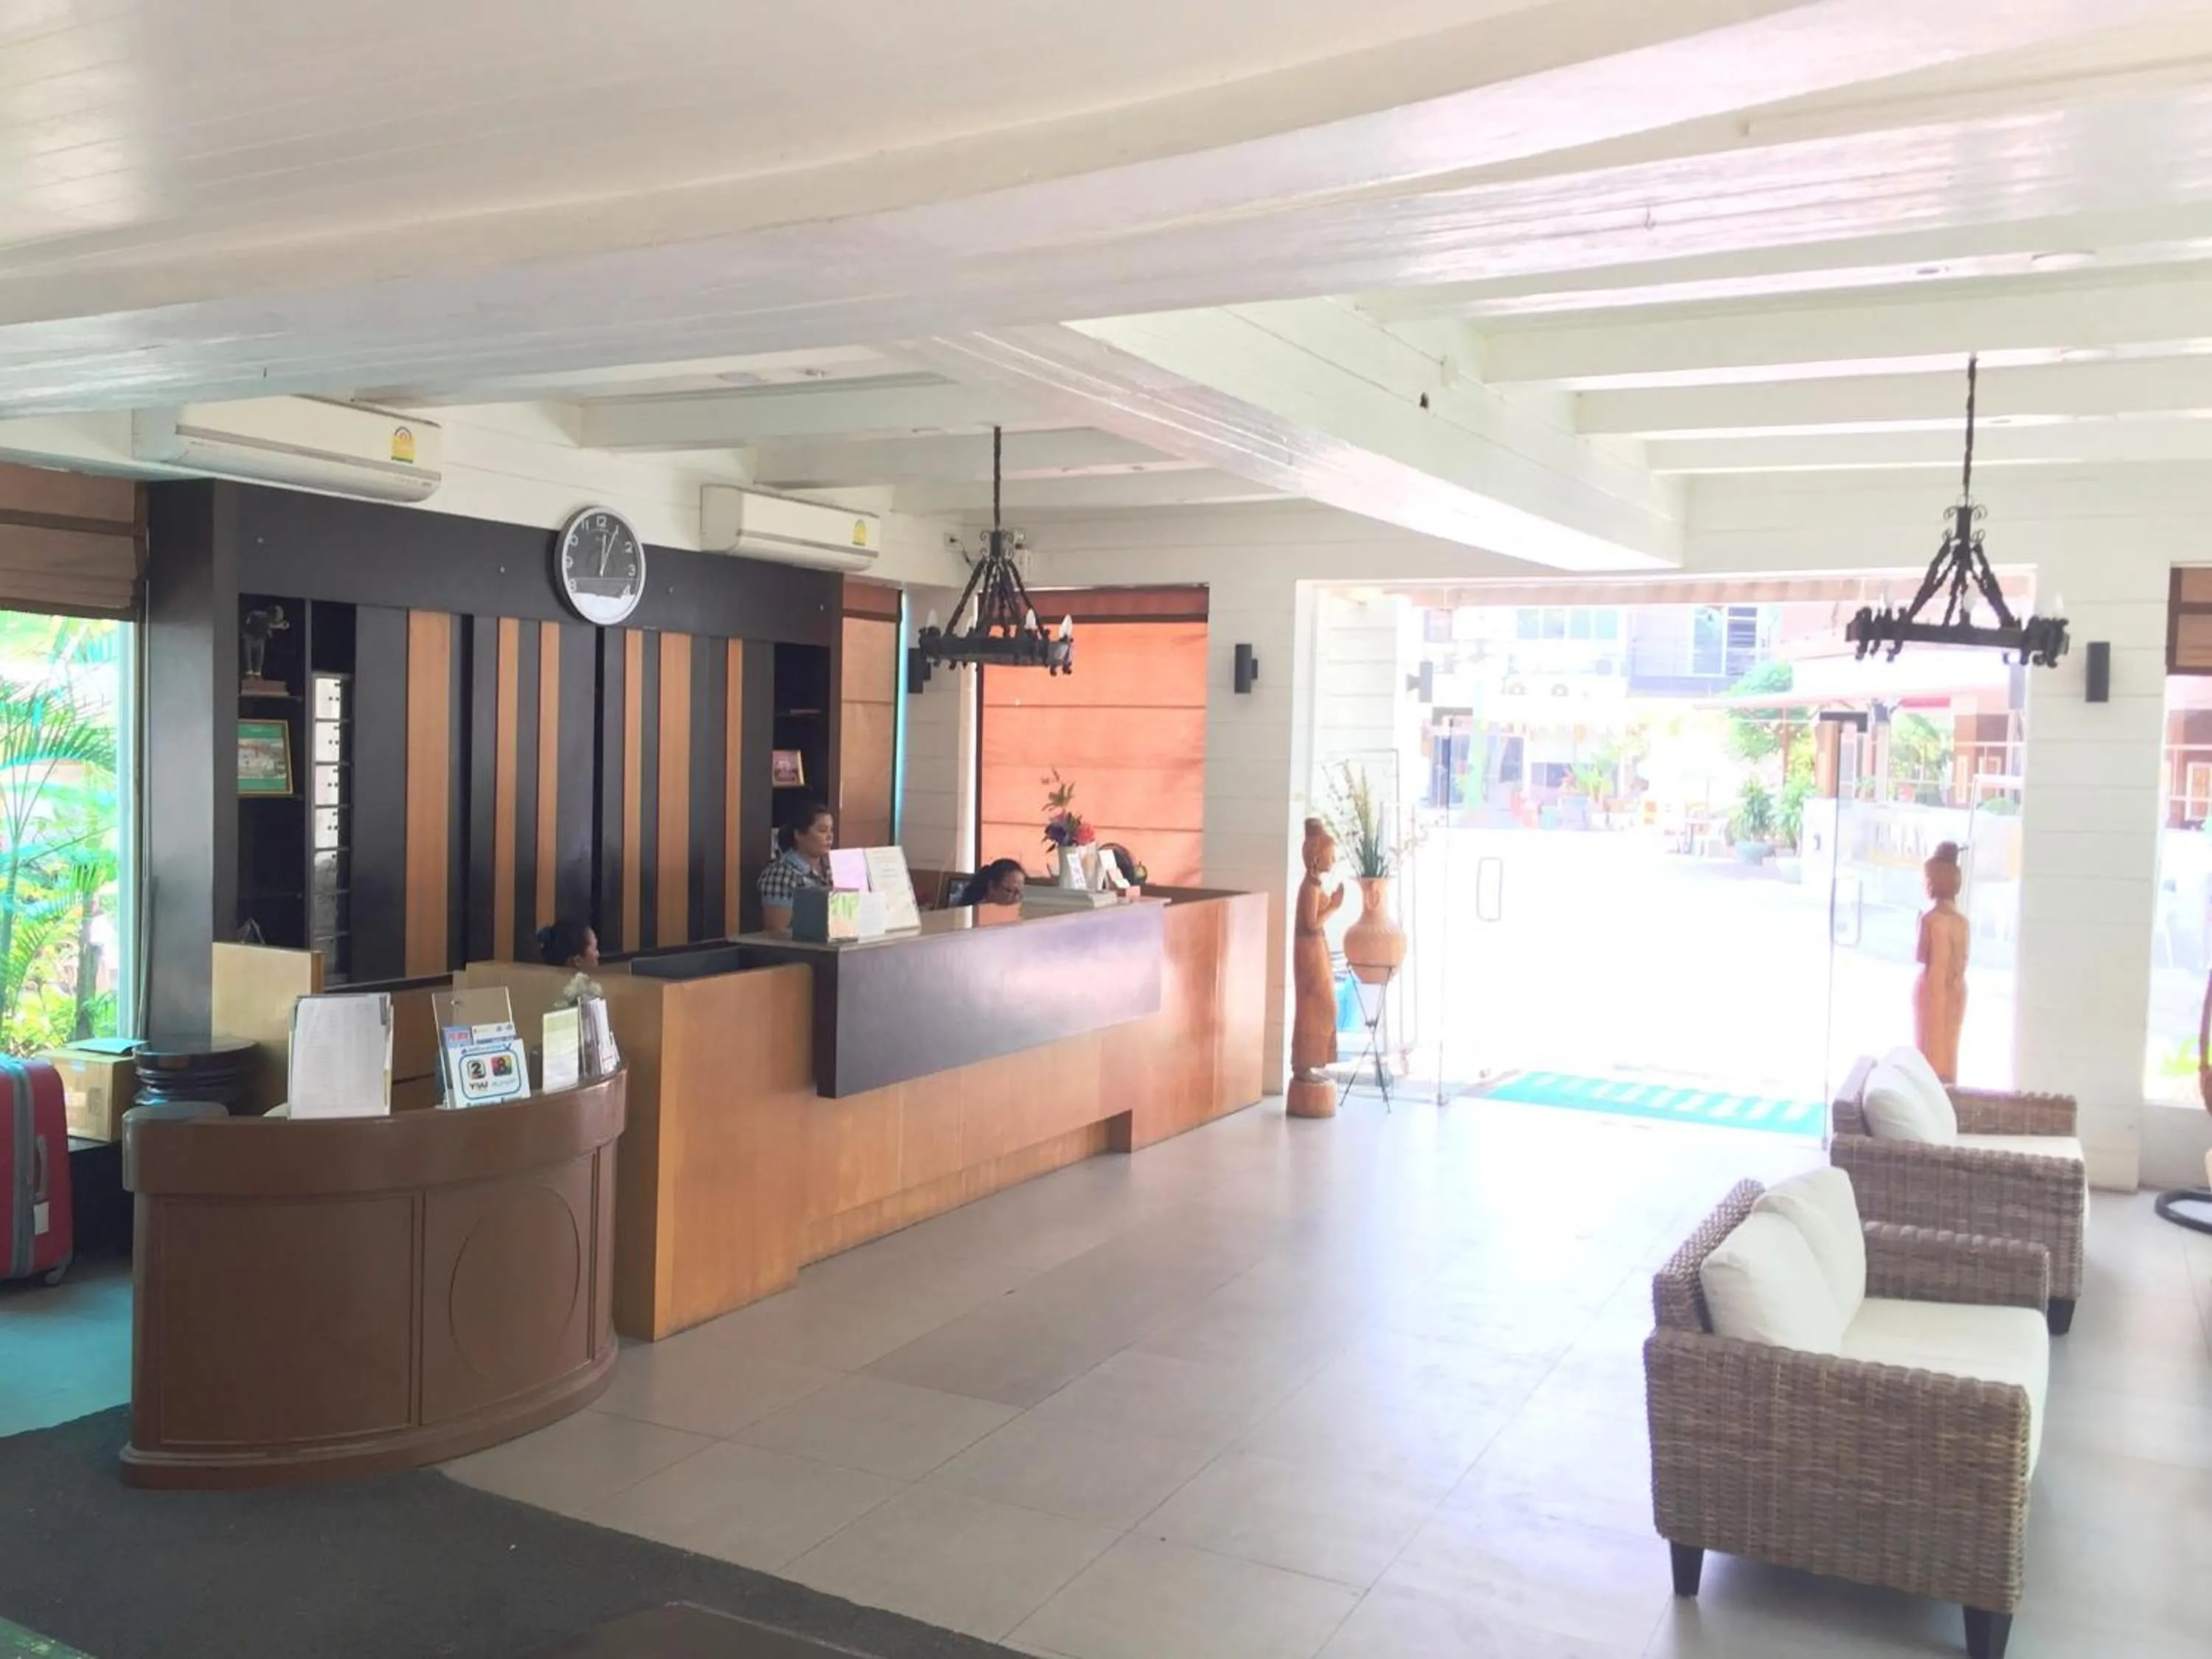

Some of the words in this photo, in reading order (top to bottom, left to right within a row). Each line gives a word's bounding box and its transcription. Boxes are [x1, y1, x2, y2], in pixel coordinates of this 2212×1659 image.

[596, 515, 607, 528] 12
[625, 540, 633, 554] 2
[628, 563, 636, 577] 3
